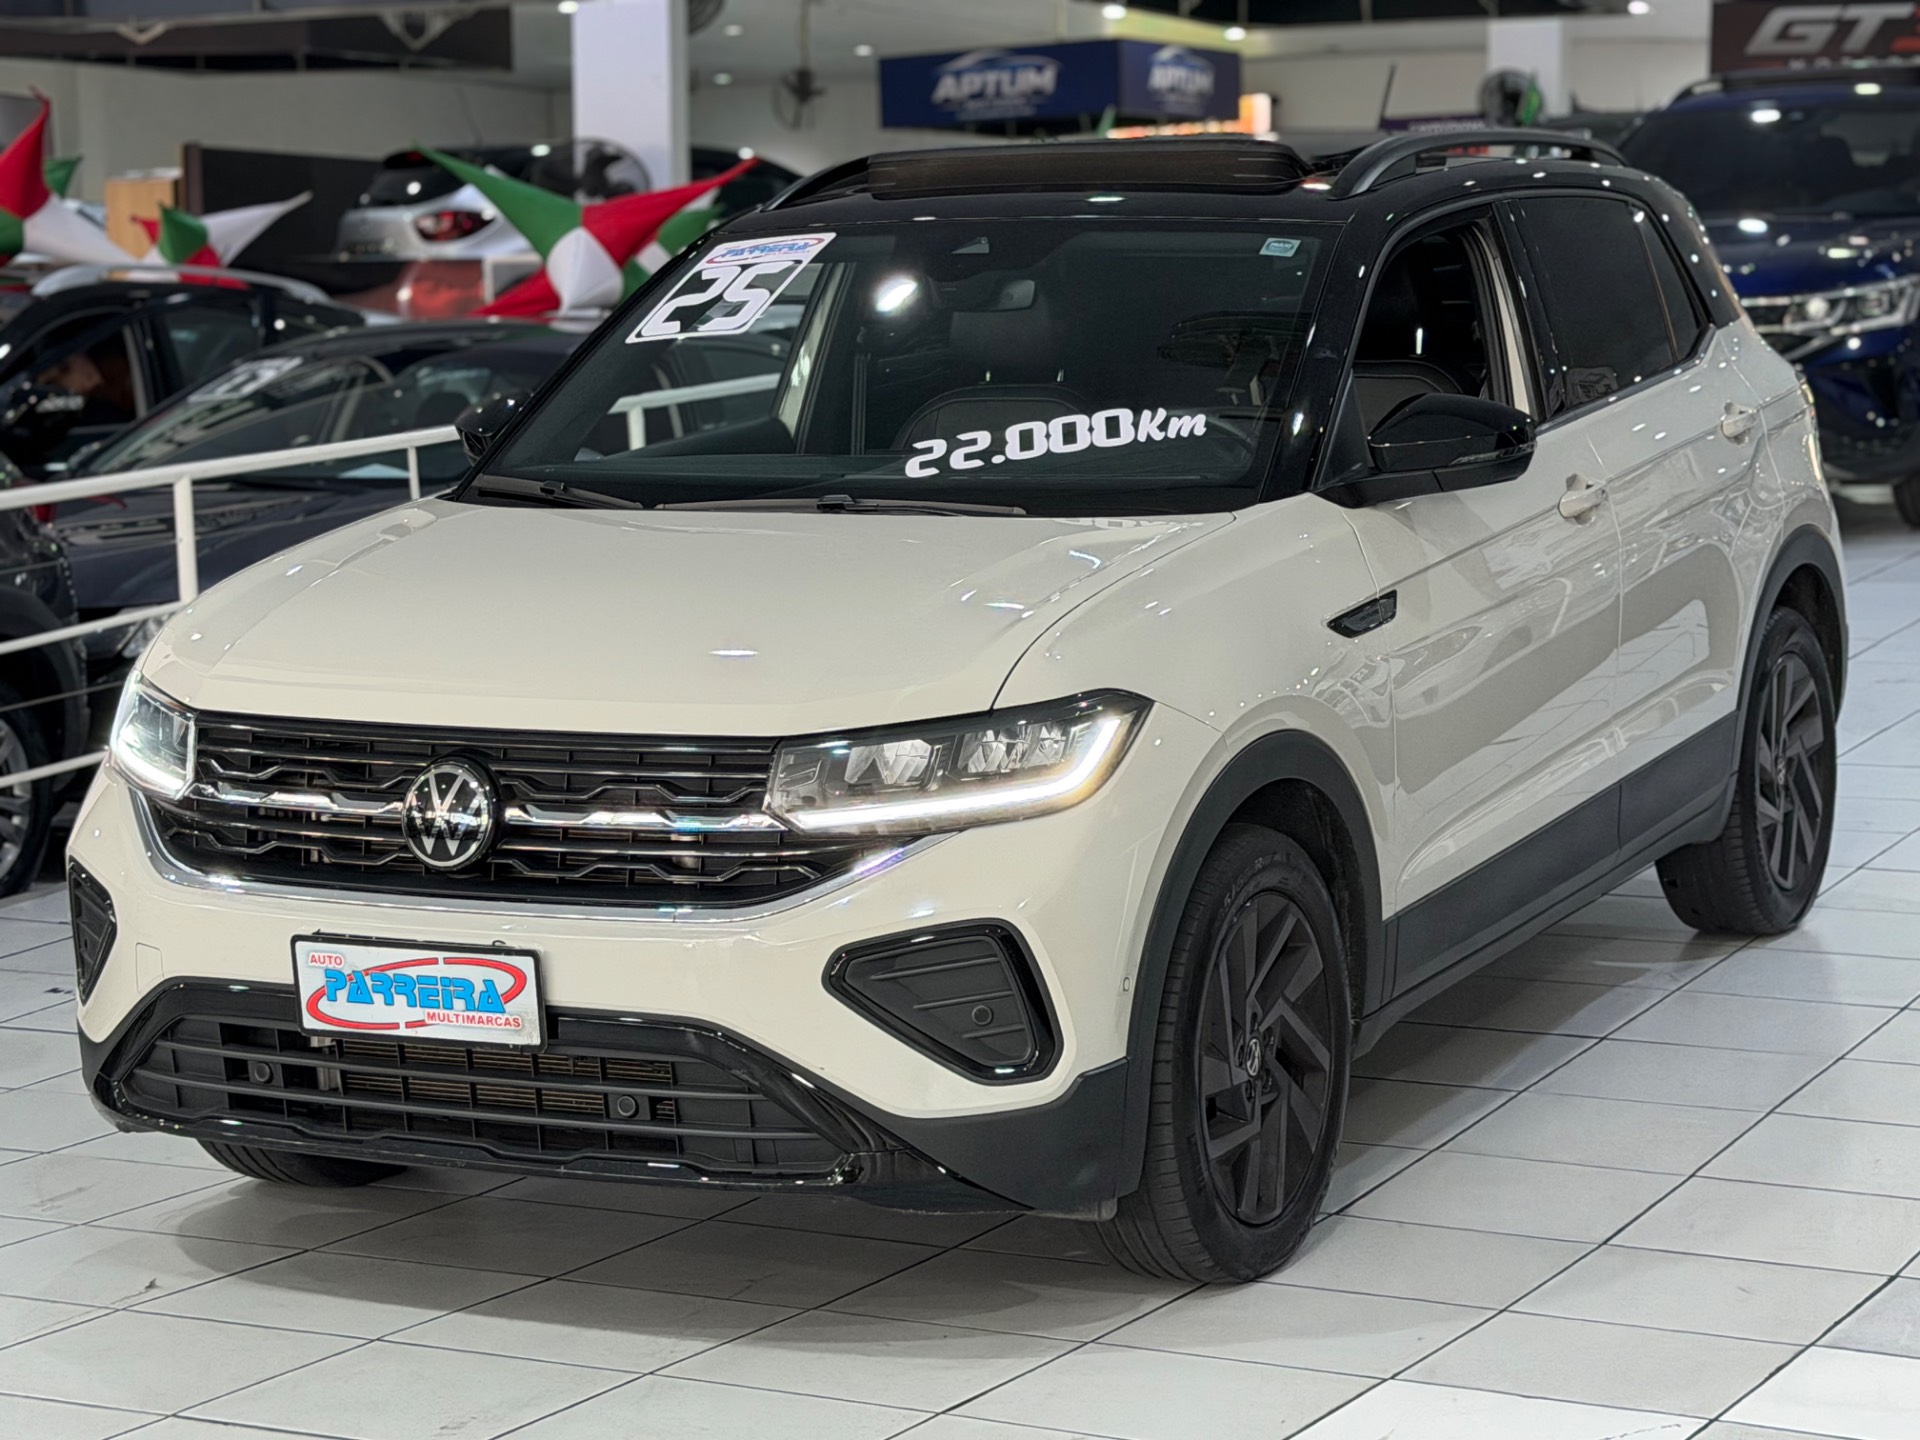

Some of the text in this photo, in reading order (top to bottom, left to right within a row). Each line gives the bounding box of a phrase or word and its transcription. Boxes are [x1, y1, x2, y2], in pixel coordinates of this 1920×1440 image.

[931, 63, 1059, 104] APTUM
[641, 261, 795, 337] 25
[309, 954, 343, 967] AUTO
[324, 968, 506, 1014] PARREIRA
[426, 1011, 522, 1029] MULTIMARCAS
